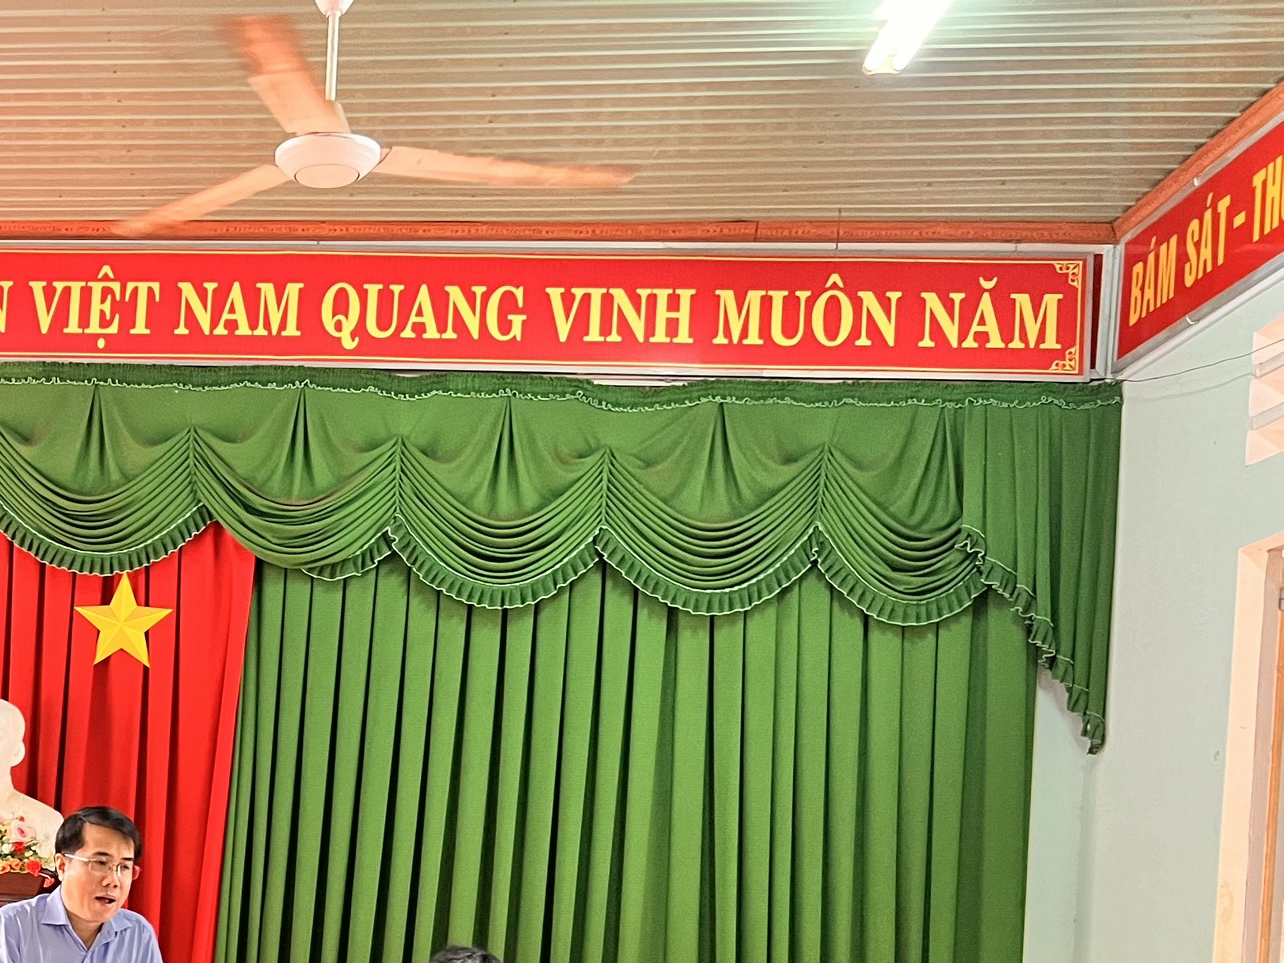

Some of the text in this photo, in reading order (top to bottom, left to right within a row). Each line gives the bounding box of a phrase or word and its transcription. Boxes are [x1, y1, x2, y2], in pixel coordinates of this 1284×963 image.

[28, 264, 161, 350] VIỆT
[173, 281, 305, 337] NAM
[321, 281, 528, 351] QUANG
[545, 287, 697, 345] VINH
[712, 273, 903, 348] MUÔN
[917, 277, 1064, 350] NĂM
[1129, 235, 1178, 327] BÁM
